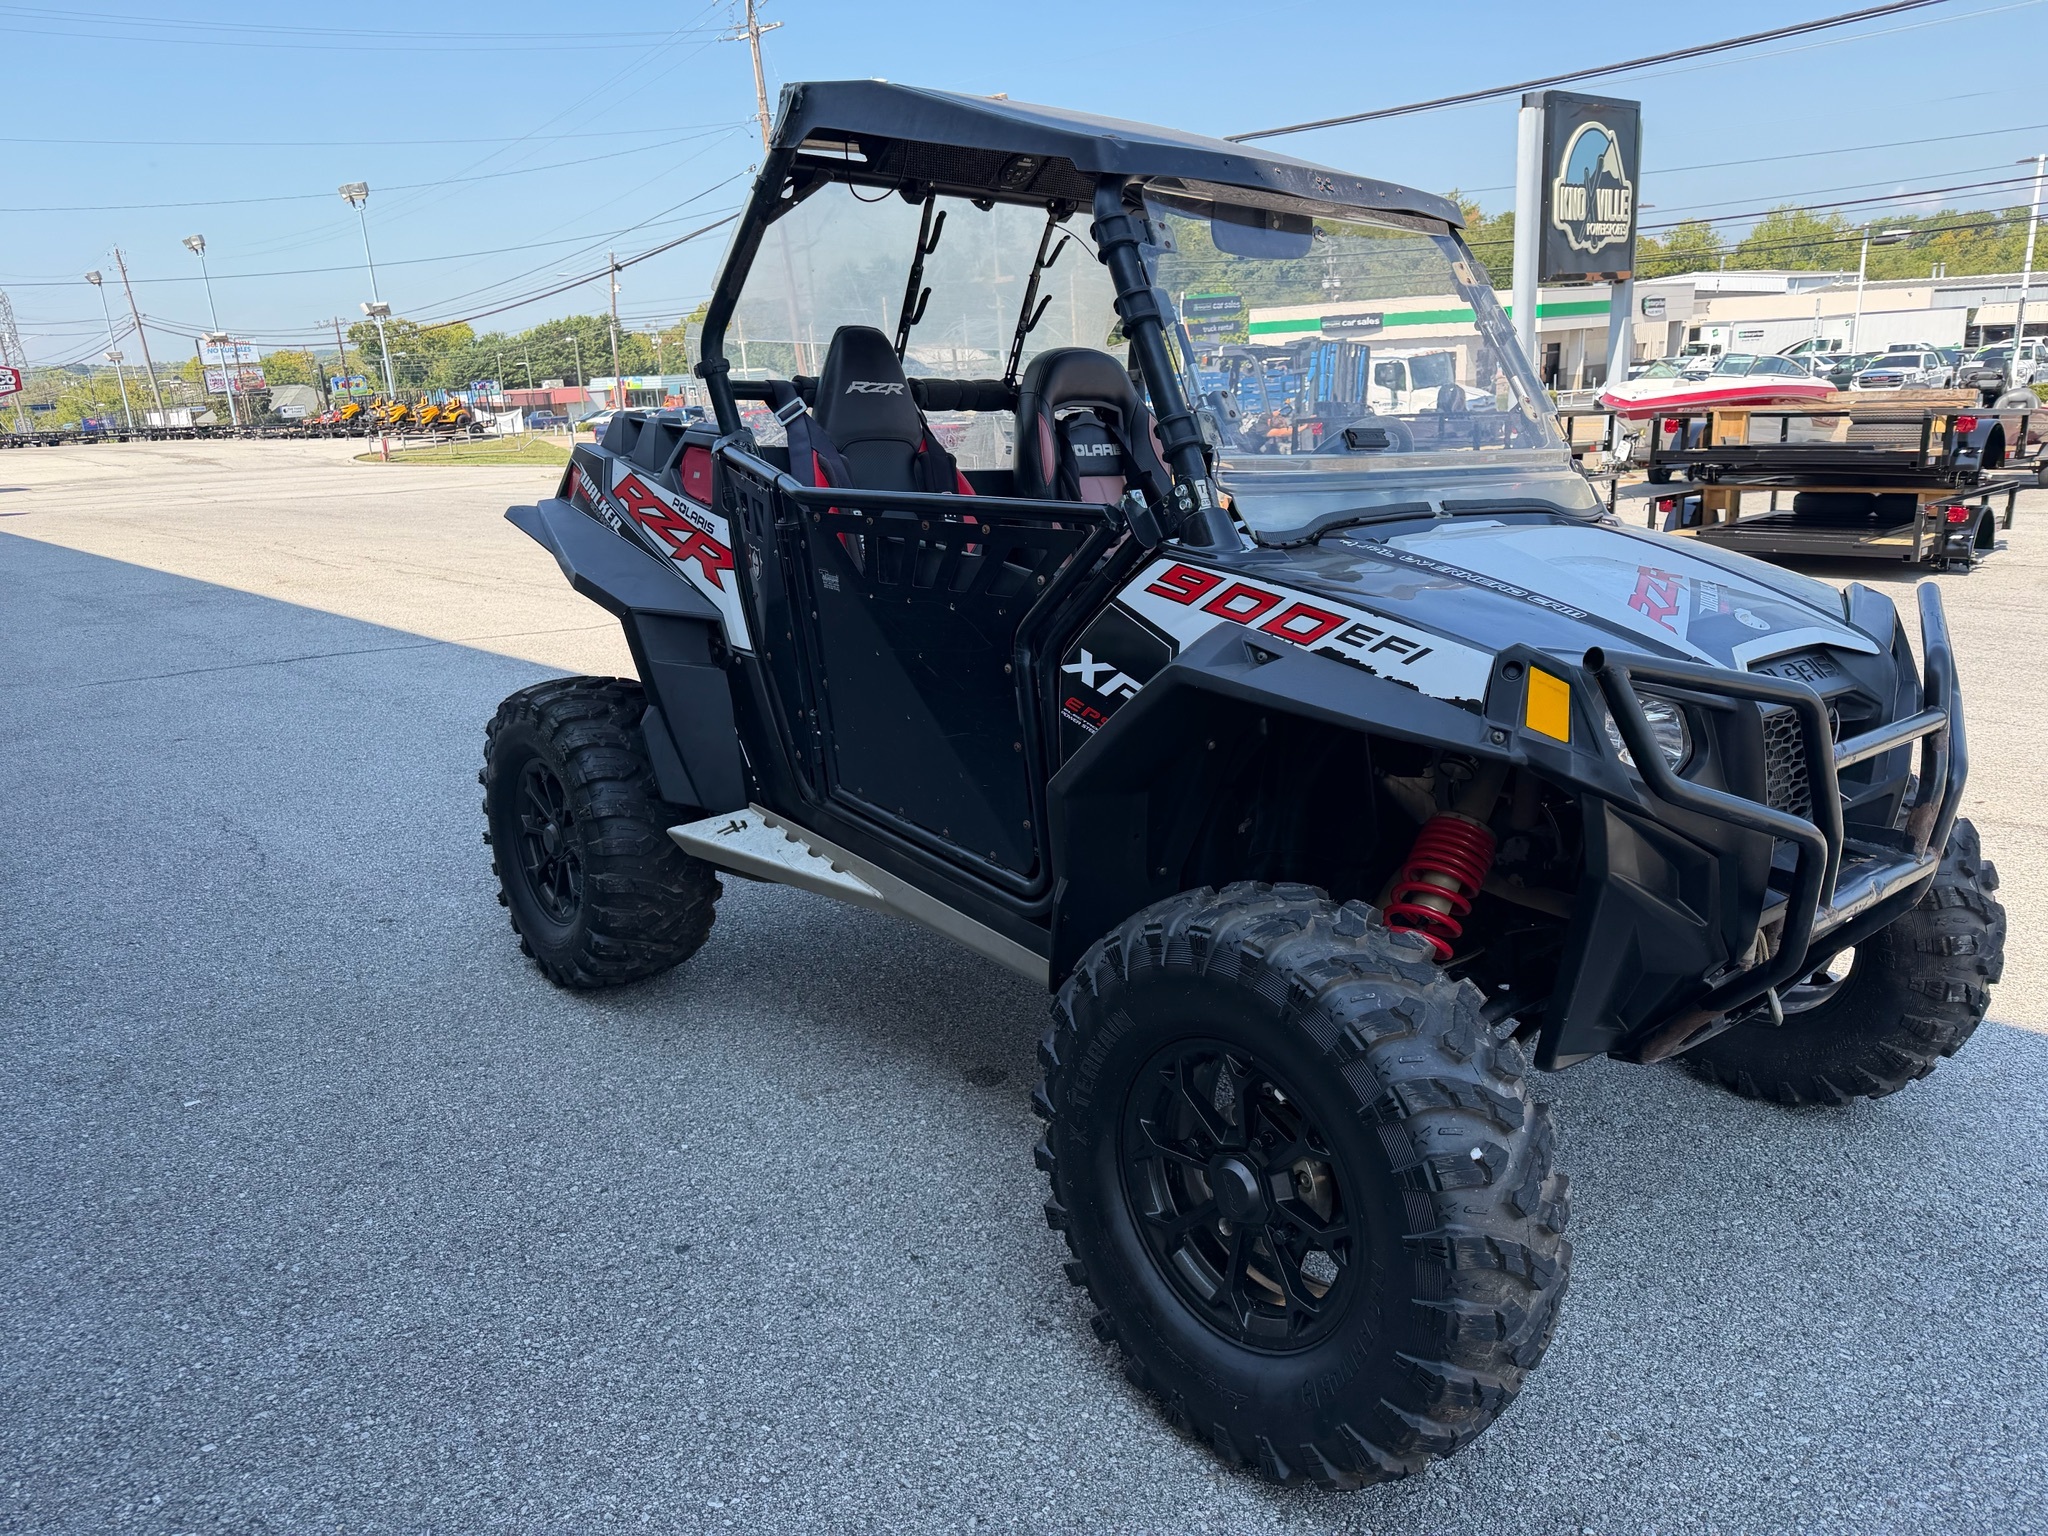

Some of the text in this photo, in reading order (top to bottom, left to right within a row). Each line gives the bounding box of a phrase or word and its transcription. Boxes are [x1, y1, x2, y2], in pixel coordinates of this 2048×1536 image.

[1356, 316, 1380, 326] sales
[845, 380, 905, 396] RZR
[579, 461, 623, 538] WALKER
[611, 471, 736, 594] RZR
[670, 497, 716, 535] POLARIS
[1143, 562, 1435, 666] 900 EFI
[1626, 565, 1689, 636] RZR
